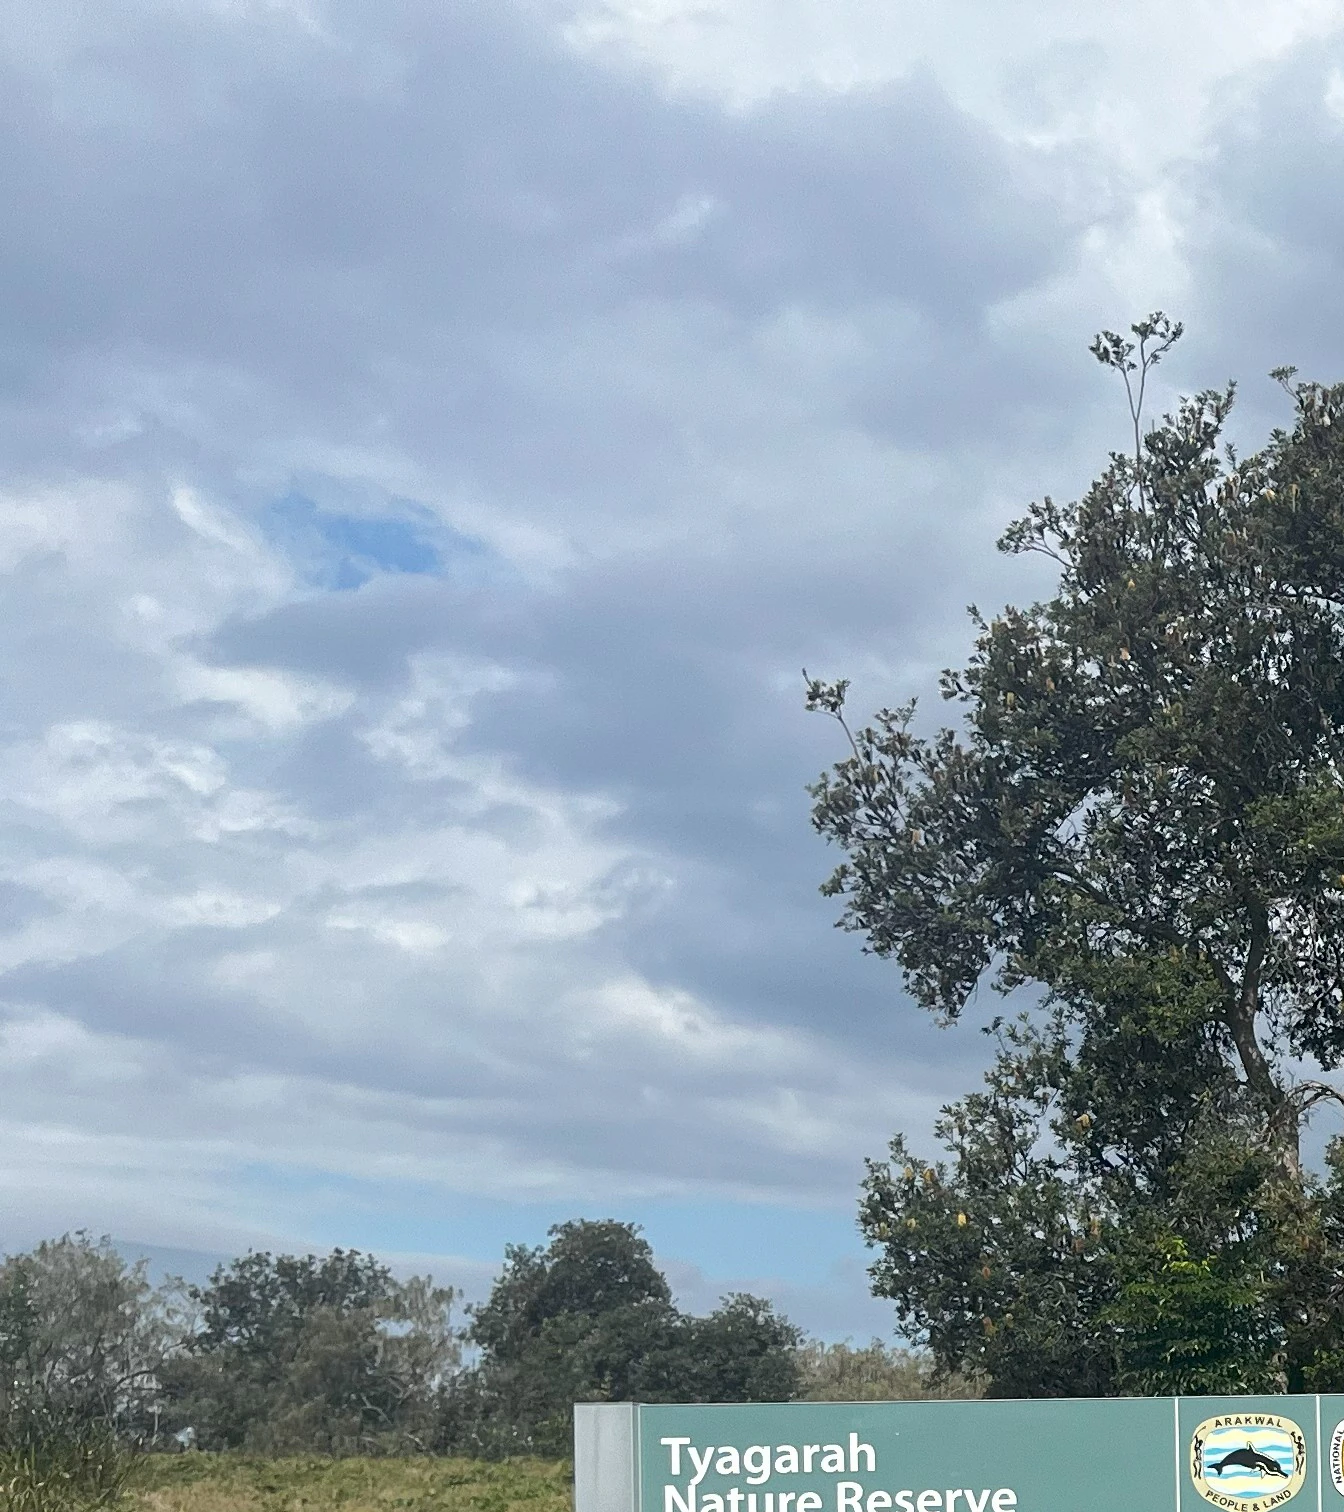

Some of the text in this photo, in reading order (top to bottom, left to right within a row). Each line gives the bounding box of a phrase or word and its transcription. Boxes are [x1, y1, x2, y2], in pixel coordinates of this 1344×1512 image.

[1214, 1416, 1283, 1428] ARAKWAL
[660, 1432, 876, 1485] Tyagarah
[1331, 1429, 1344, 1484] NATIONAL
[1205, 1489, 1292, 1512] PEOPLE & LAND
